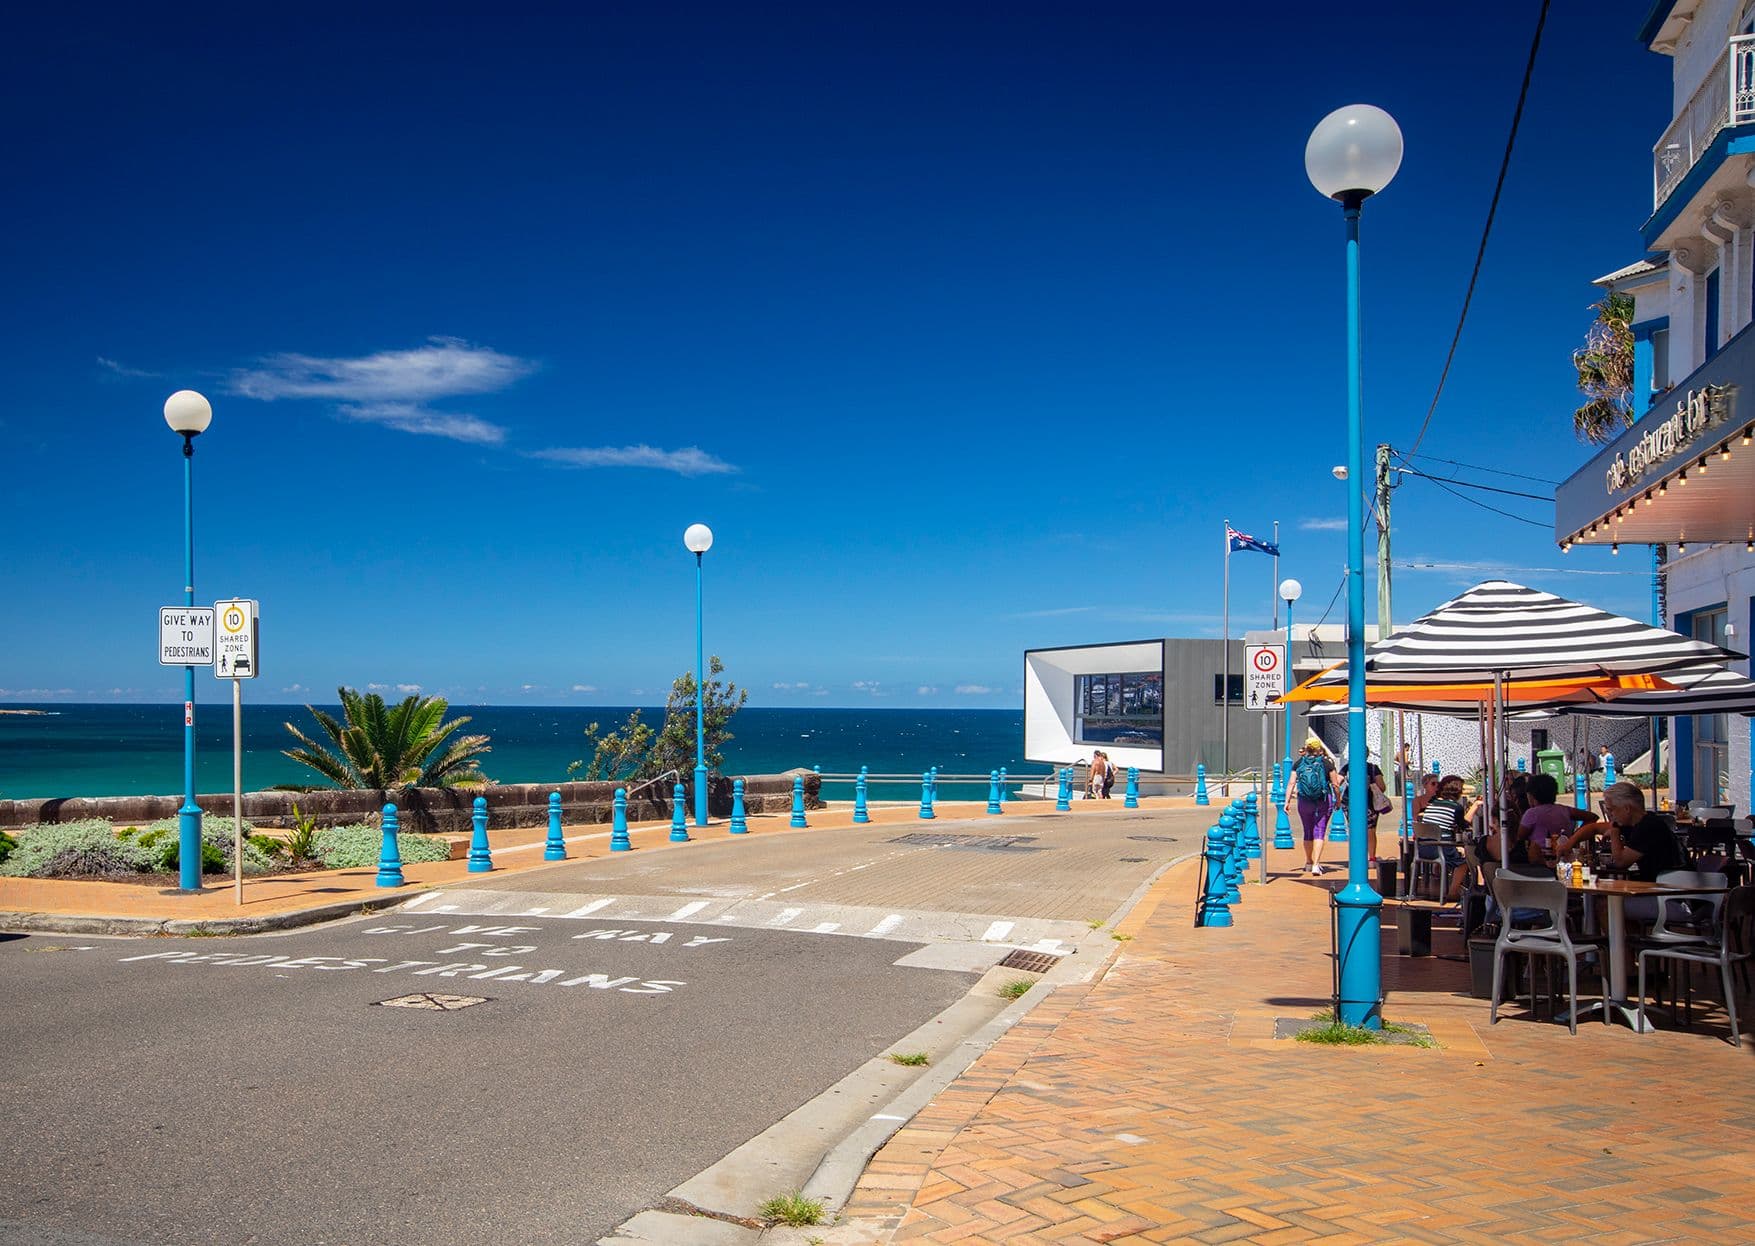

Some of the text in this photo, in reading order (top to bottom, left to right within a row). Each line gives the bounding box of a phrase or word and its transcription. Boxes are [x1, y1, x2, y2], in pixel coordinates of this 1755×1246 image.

[164, 615, 211, 626] GIVE WAY
[228, 614, 239, 625] 10
[181, 631, 193, 642] TO
[219, 635, 249, 643] SHARED
[164, 646, 210, 658] PEDESTRIANS
[1260, 655, 1271, 666] 10
[1249, 673, 1282, 681] SHARED
[1255, 681, 1276, 689] ZONE
[361, 925, 734, 947] GIVE WAY
[435, 942, 538, 956] TO
[117, 951, 687, 994] PEDESTRIANS
